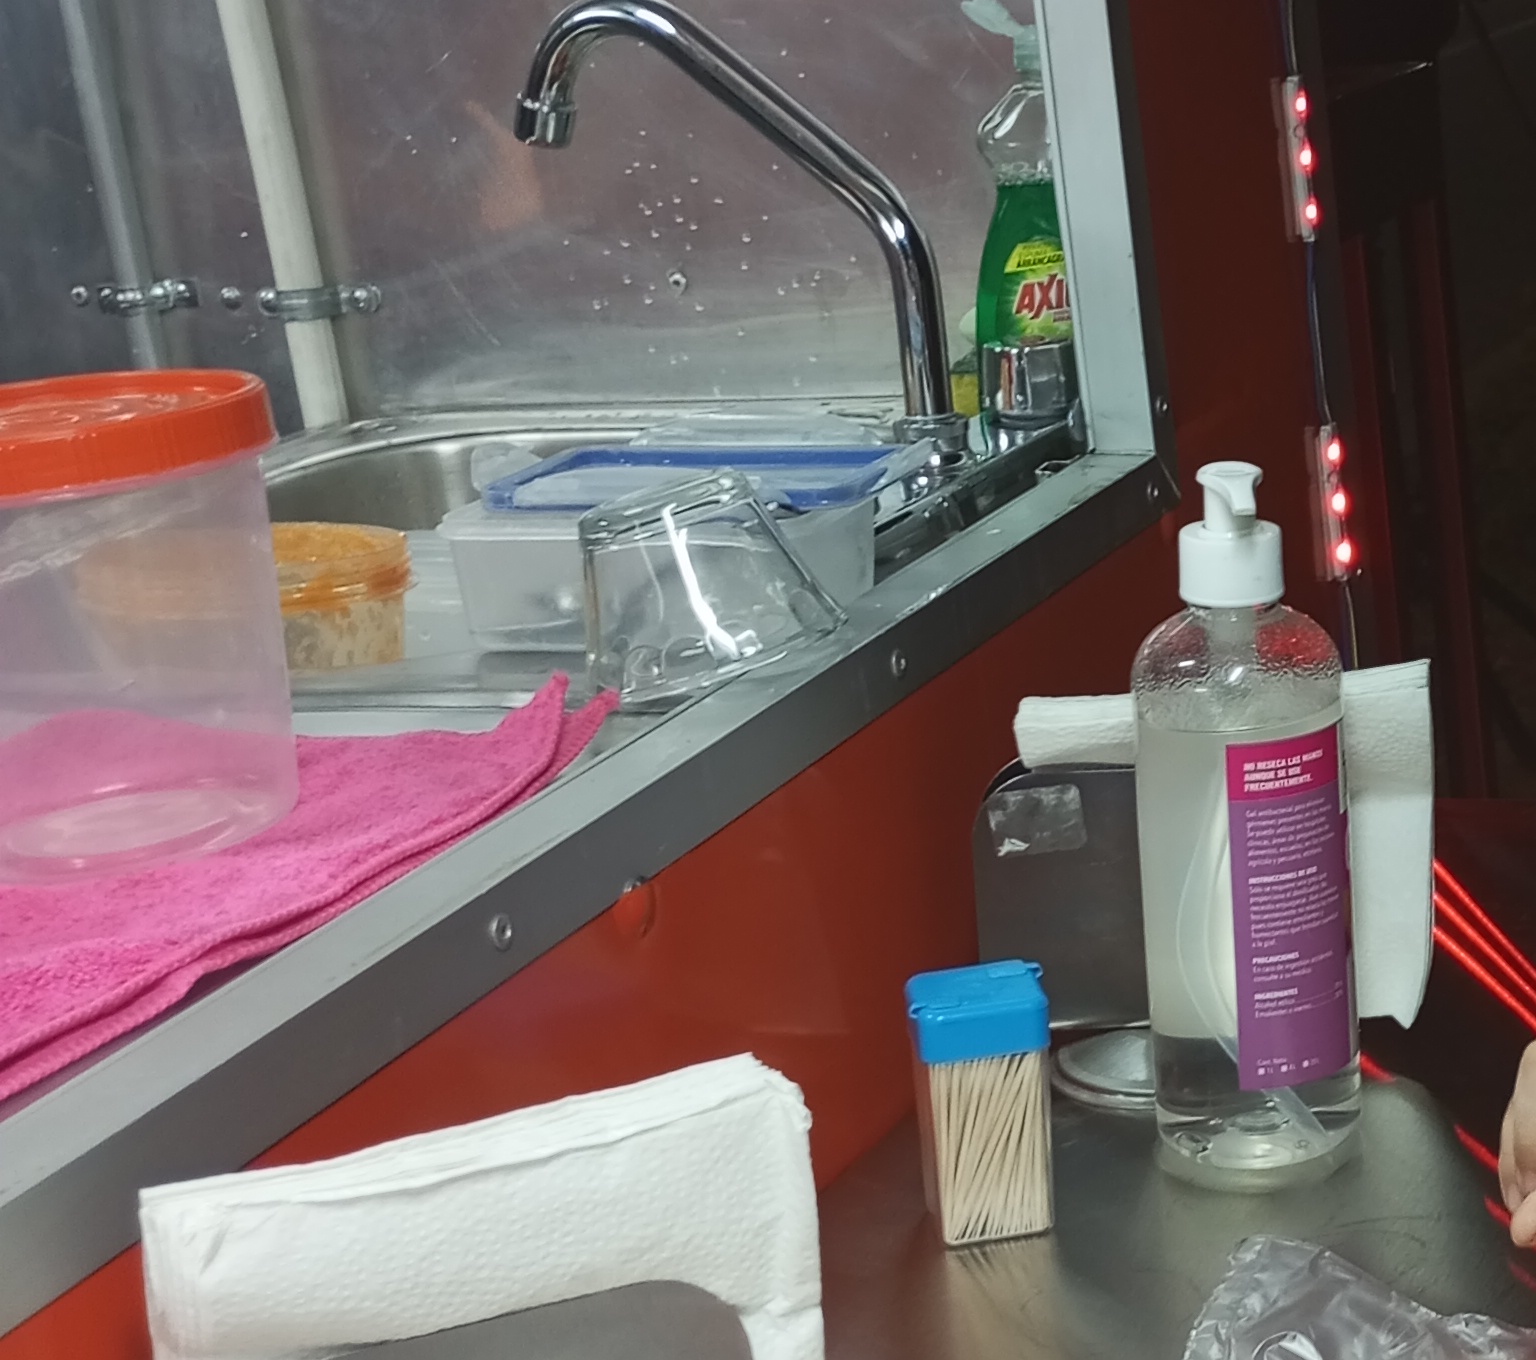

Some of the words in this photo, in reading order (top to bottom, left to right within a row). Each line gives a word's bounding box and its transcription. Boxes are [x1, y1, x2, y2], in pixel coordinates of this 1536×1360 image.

[1243, 762, 1255, 771] NO
[1256, 759, 1286, 771] RESECA
[1287, 755, 1301, 766] LAS
[1244, 770, 1276, 782] AUNQUE
[1248, 871, 1298, 885] INSTRUCCIONES
[1252, 951, 1300, 965] PRECAUCIONES
